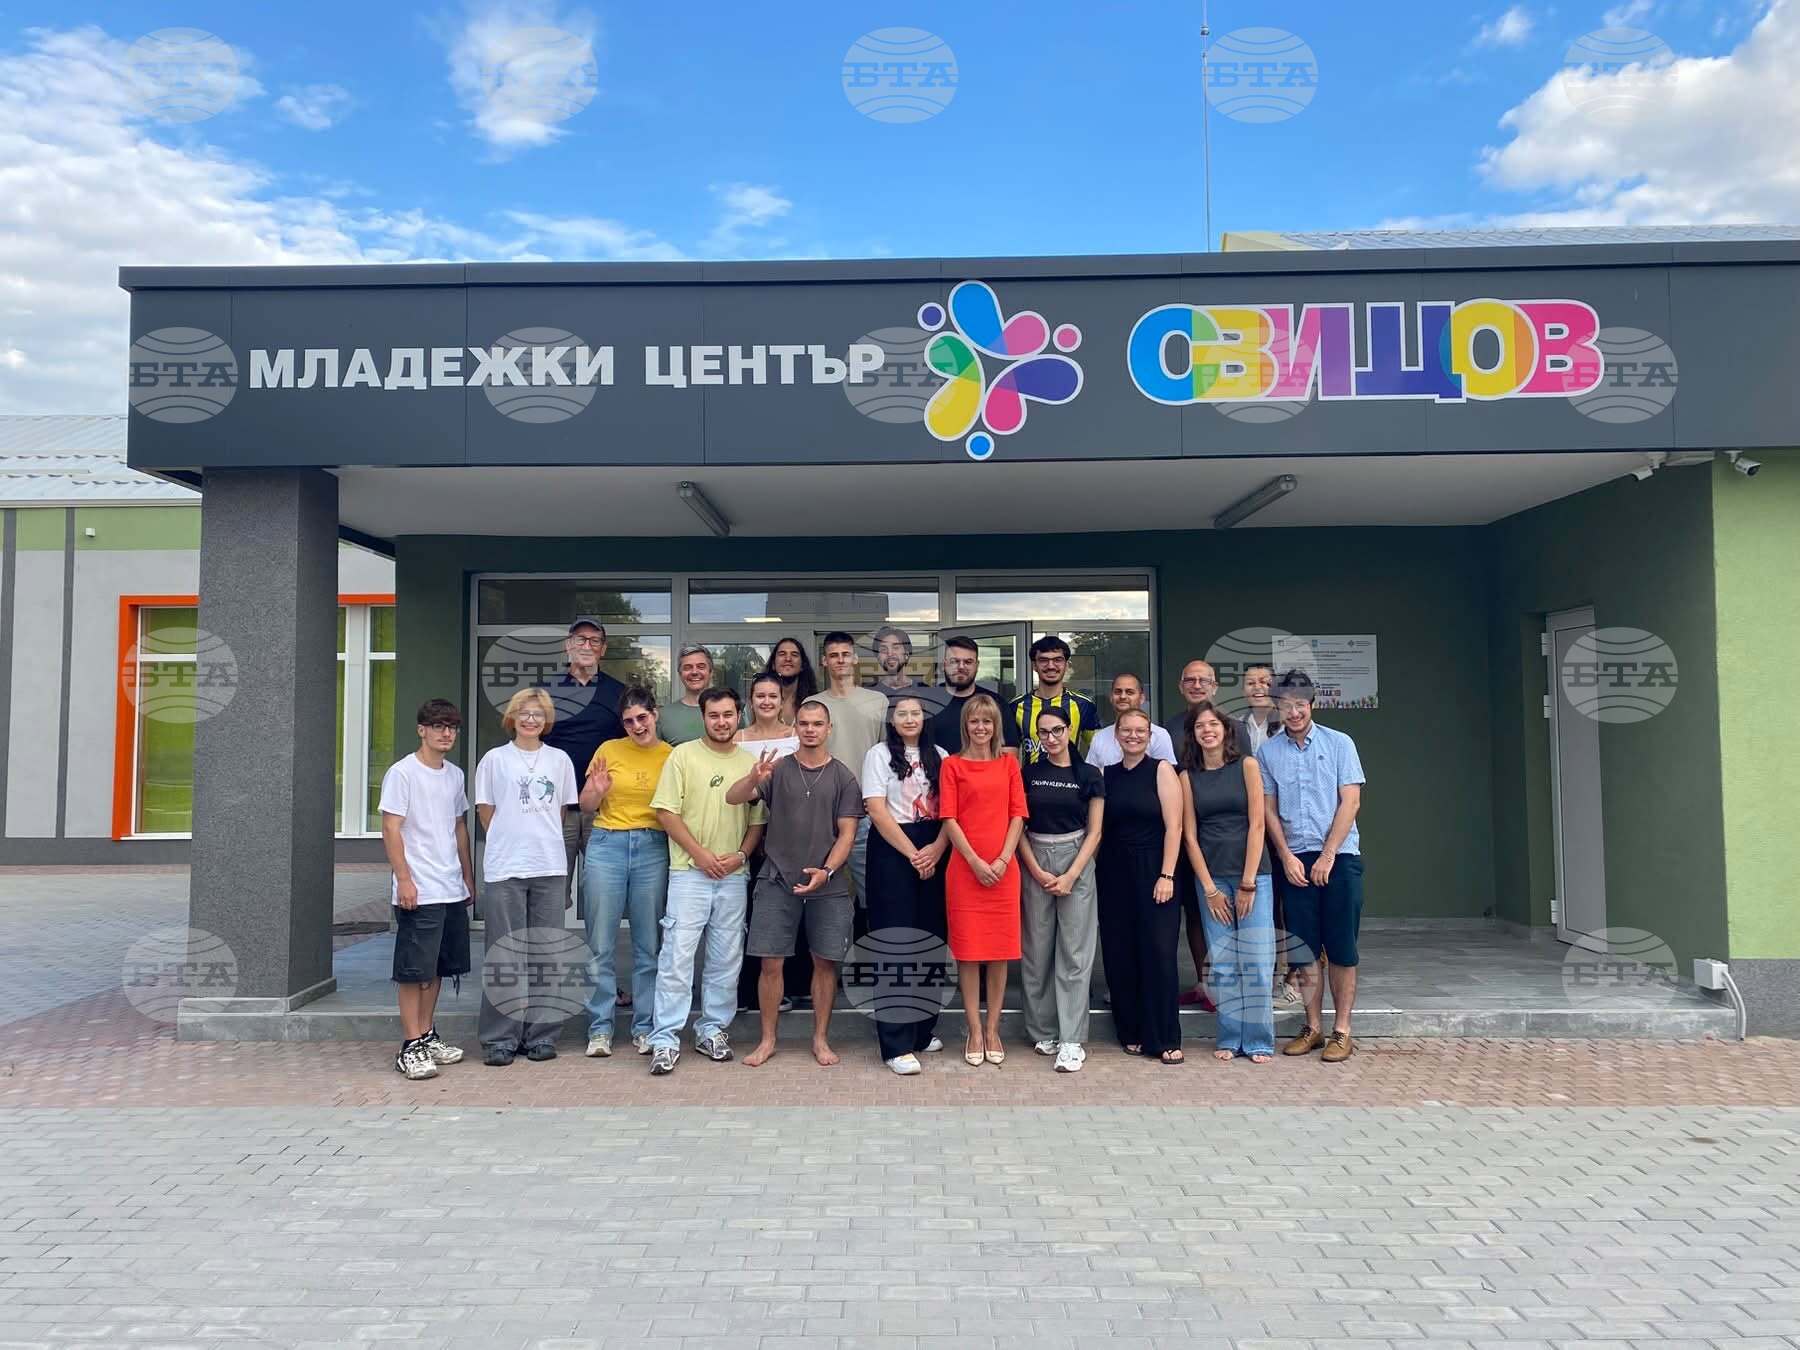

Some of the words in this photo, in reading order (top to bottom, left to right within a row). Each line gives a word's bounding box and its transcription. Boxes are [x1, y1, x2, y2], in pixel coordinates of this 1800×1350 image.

[249, 345, 615, 391] МЛАДЕЖКИ
[645, 343, 885, 389] ЦЕНТЪР
[1126, 298, 1604, 405] СВИЩОВ
